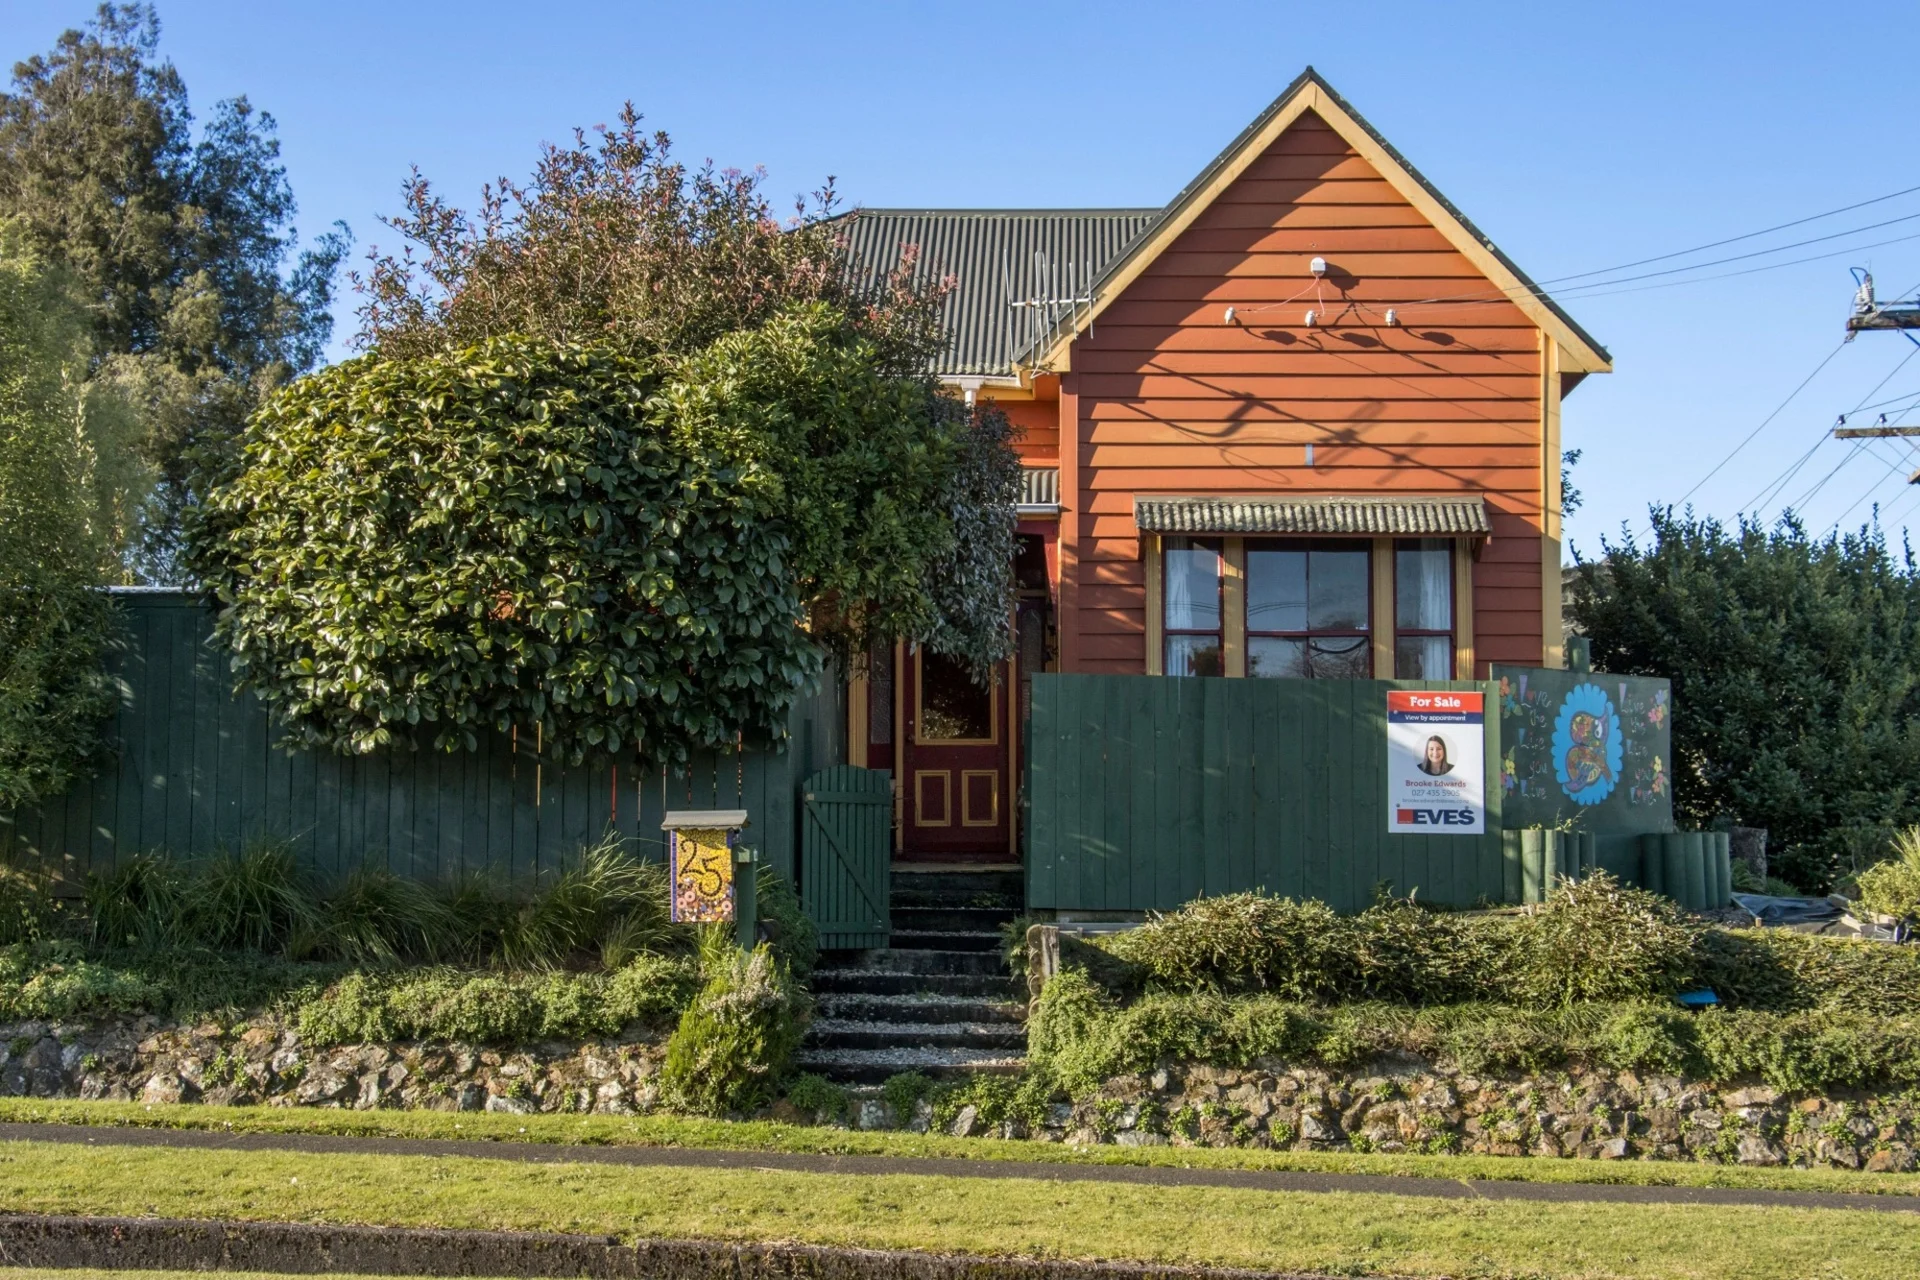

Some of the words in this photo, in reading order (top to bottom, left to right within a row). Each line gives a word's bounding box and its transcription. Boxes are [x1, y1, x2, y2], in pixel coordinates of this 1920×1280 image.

[1410, 696, 1431, 707] For
[1434, 696, 1461, 708] Sale
[1420, 714, 1428, 722] by
[1428, 714, 1466, 722] appointment
[1434, 780, 1467, 788] Edwards
[1411, 789, 1425, 797] 027
[1426, 789, 1441, 797] 435
[1414, 809, 1475, 825] EVES
[679, 838, 723, 897] 25
